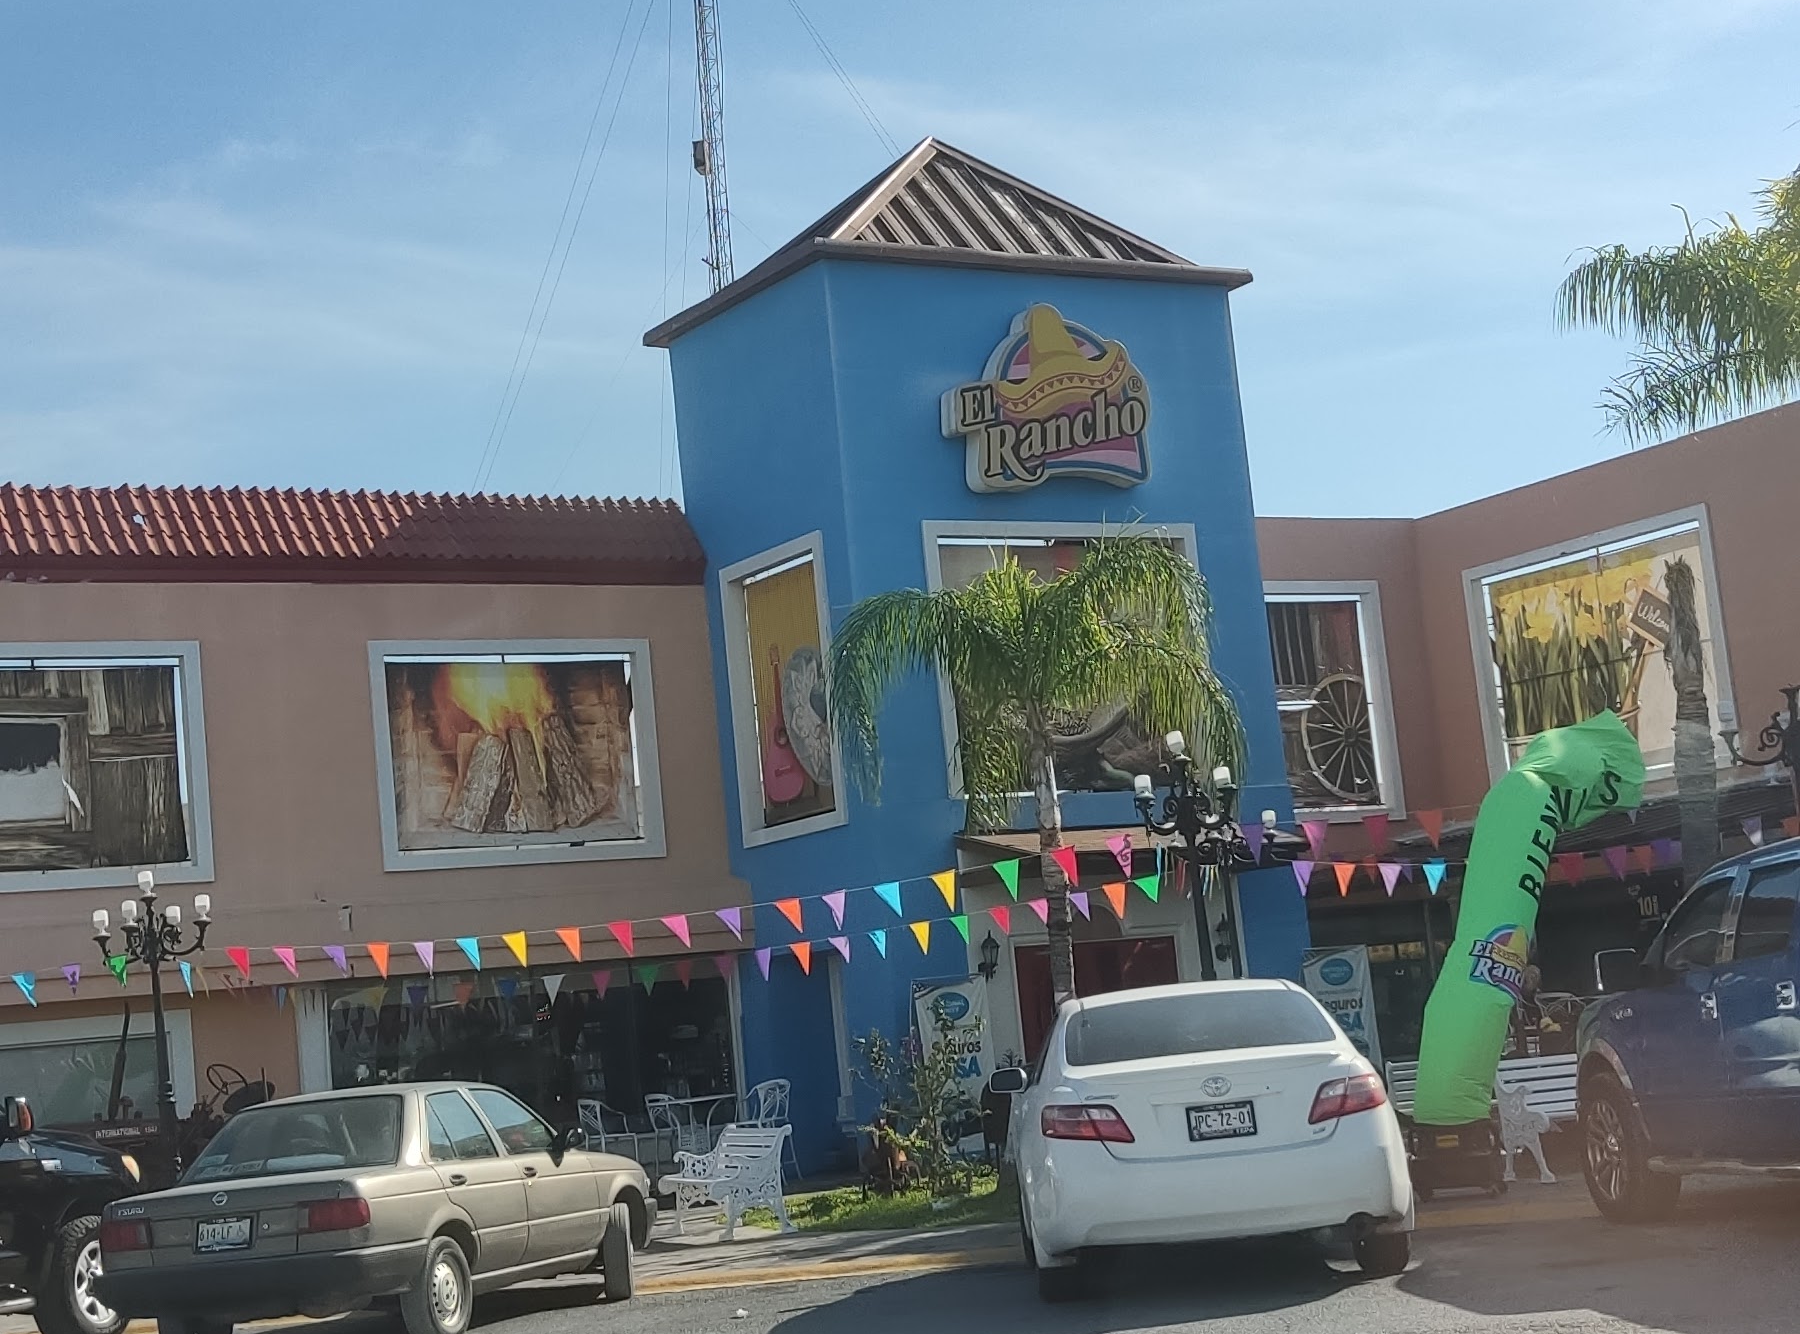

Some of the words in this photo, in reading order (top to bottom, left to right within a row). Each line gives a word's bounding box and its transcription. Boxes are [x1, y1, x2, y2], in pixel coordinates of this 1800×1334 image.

[959, 384, 996, 427] El
[983, 388, 1146, 482] Rancho
[1469, 940, 1494, 957] El
